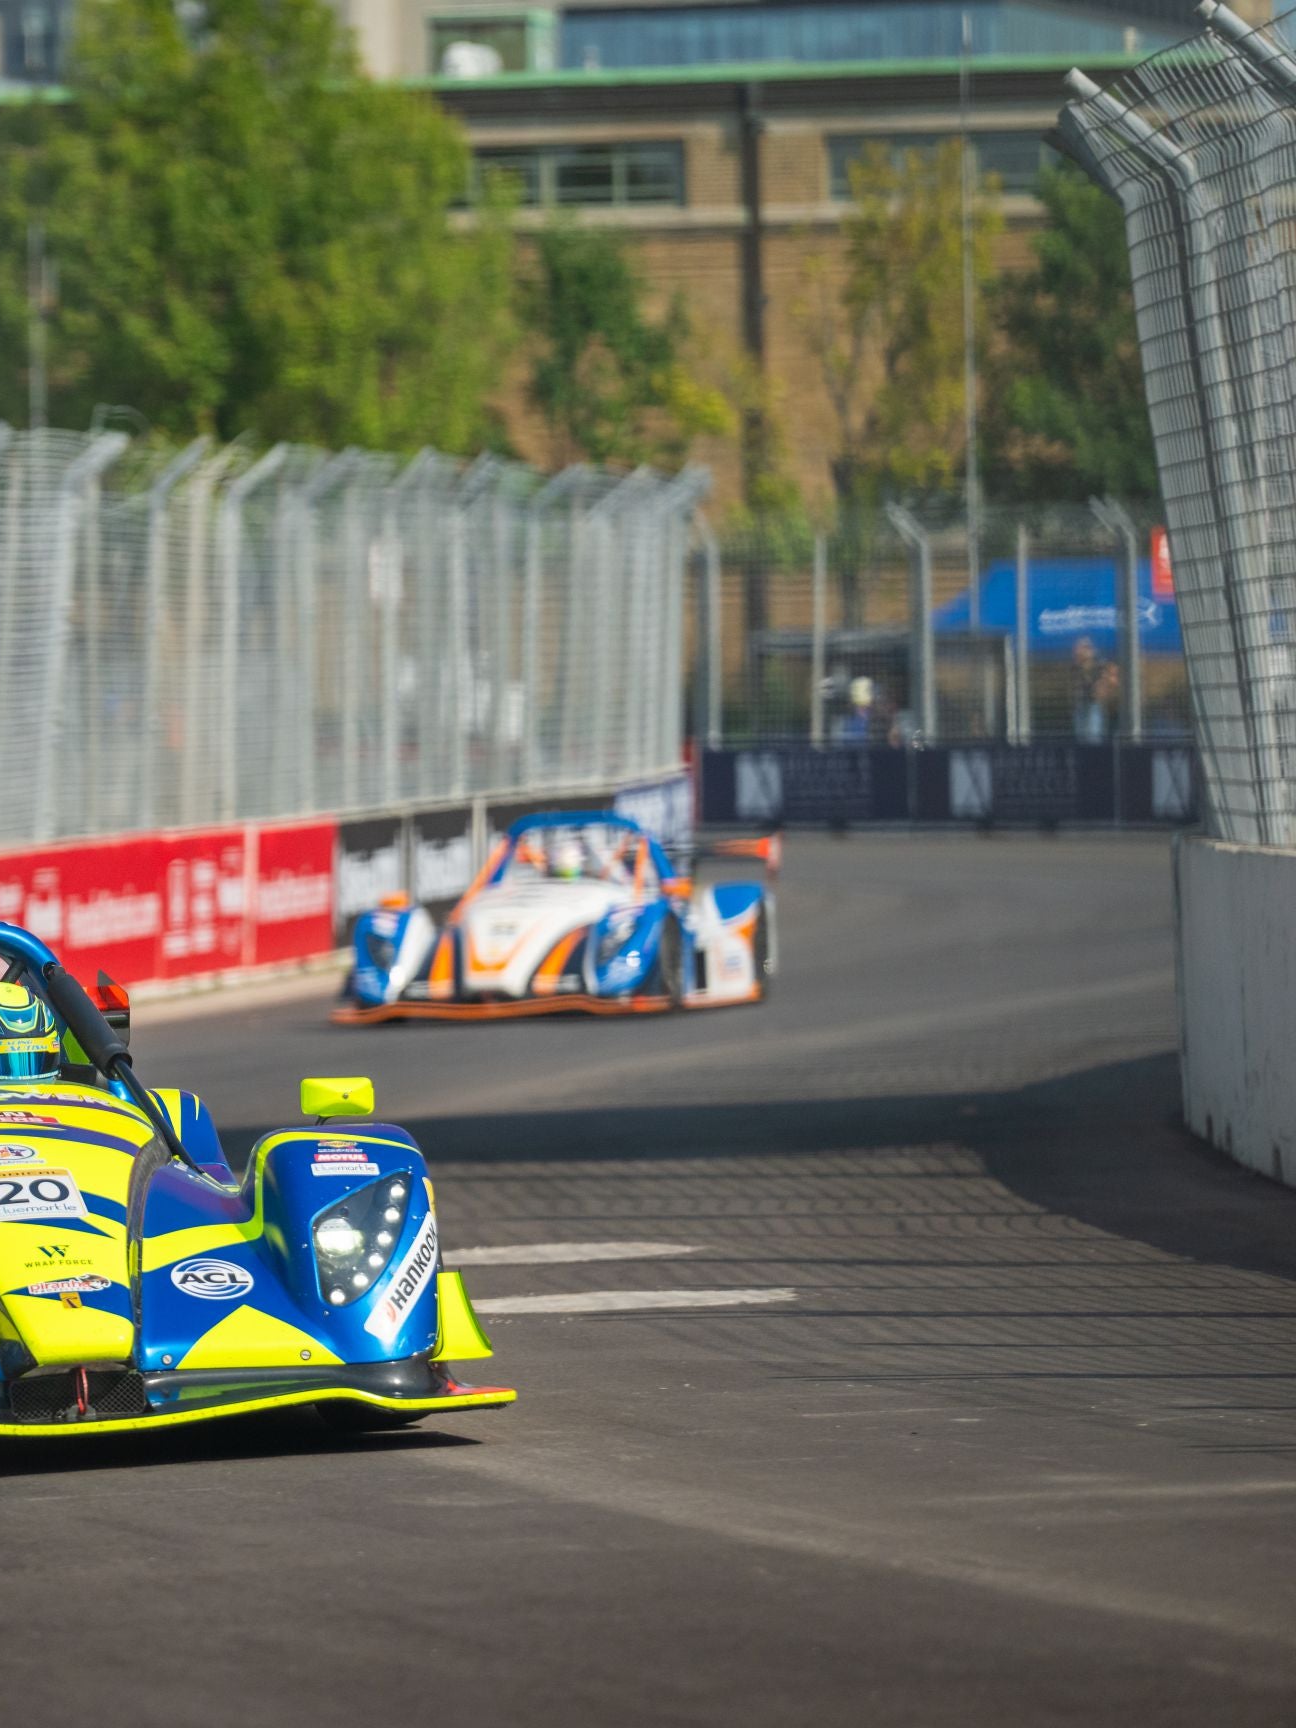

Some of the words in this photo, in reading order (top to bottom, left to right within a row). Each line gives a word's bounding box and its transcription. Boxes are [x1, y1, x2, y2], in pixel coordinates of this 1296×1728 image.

[24, 1260, 55, 1268] WRAP
[59, 1258, 94, 1266] FORCE
[178, 1272, 250, 1285] ACL
